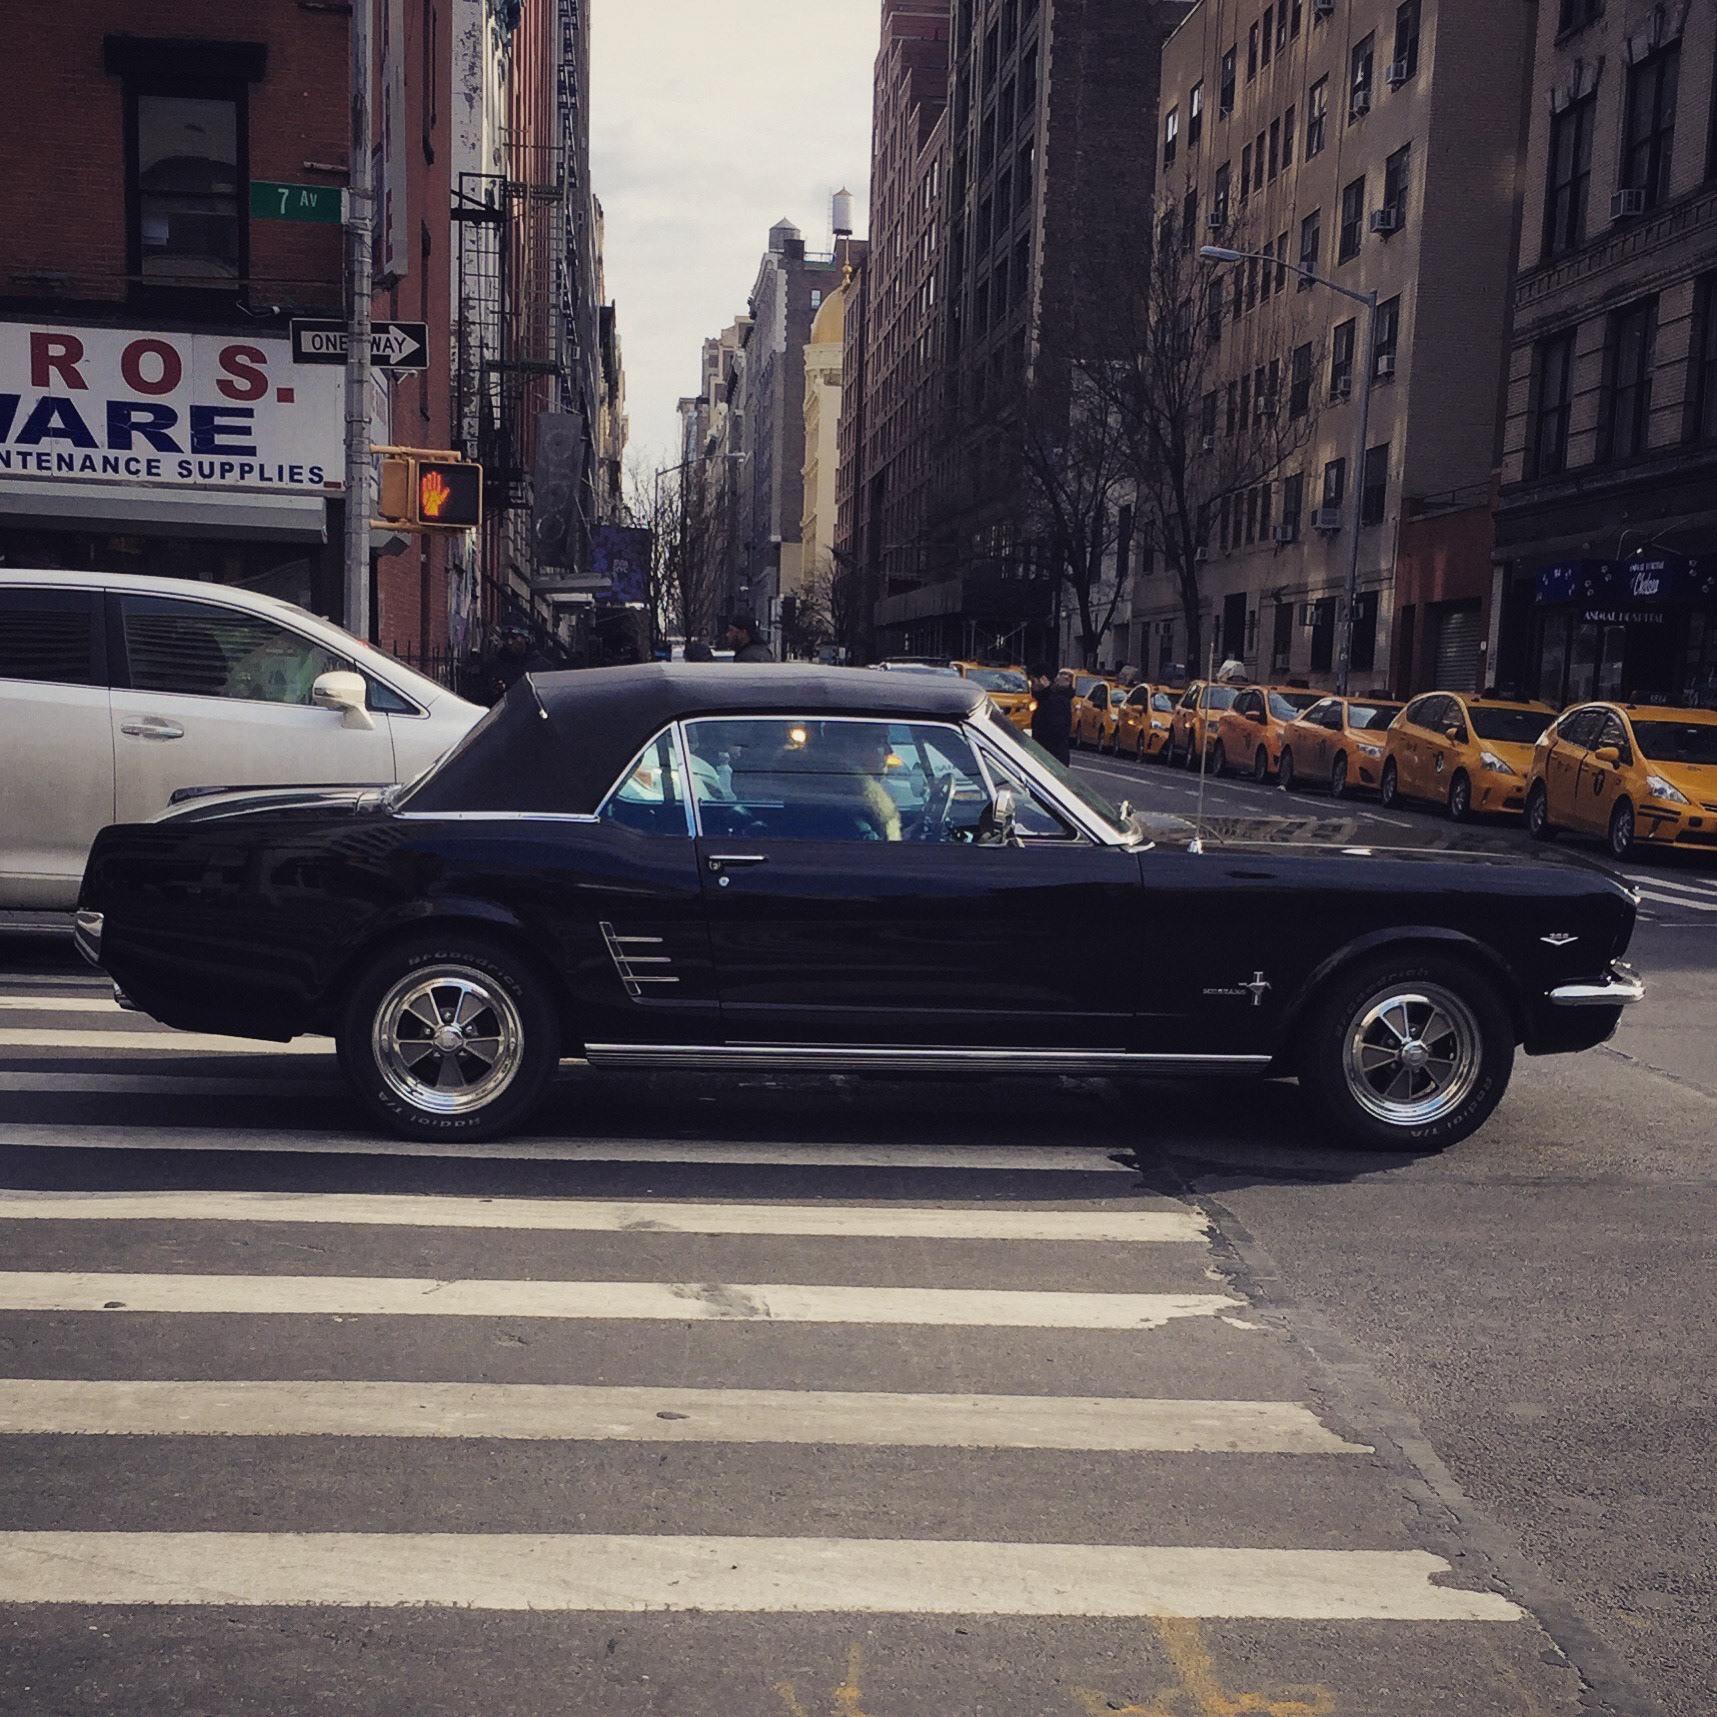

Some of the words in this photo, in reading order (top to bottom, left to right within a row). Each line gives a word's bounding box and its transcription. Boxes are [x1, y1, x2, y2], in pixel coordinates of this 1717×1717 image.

[278, 188, 288, 214] 7
[299, 190, 318, 208] AV
[311, 333, 349, 352] ONE
[370, 335, 407, 354] WAY
[0, 394, 257, 457] ARE
[0, 450, 162, 477] NTENANCE
[178, 459, 324, 484] SUPPLIES
[1584, 610, 1616, 622] ANIMAL
[1618, 611, 1664, 623] HOSPITAL
